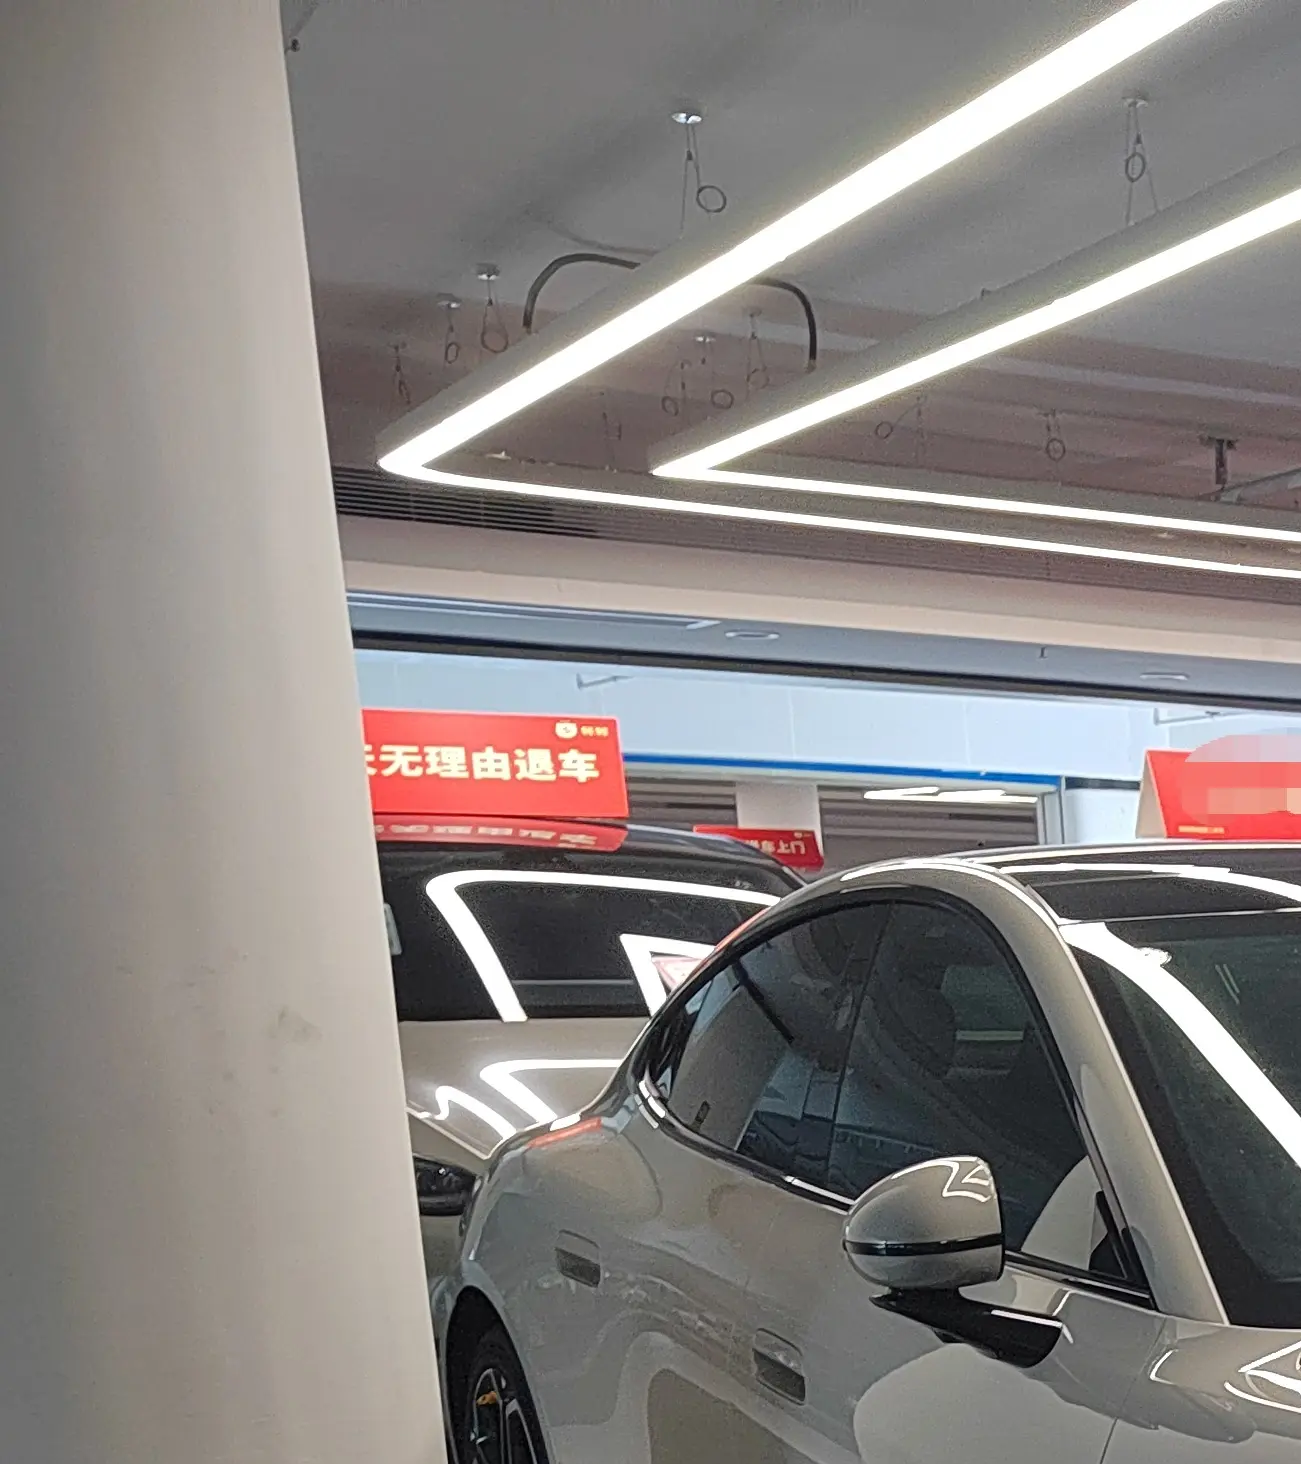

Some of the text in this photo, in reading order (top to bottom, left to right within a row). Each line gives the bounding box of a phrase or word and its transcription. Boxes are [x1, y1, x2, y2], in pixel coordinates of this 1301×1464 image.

[364, 744, 600, 783] 无理由退车
